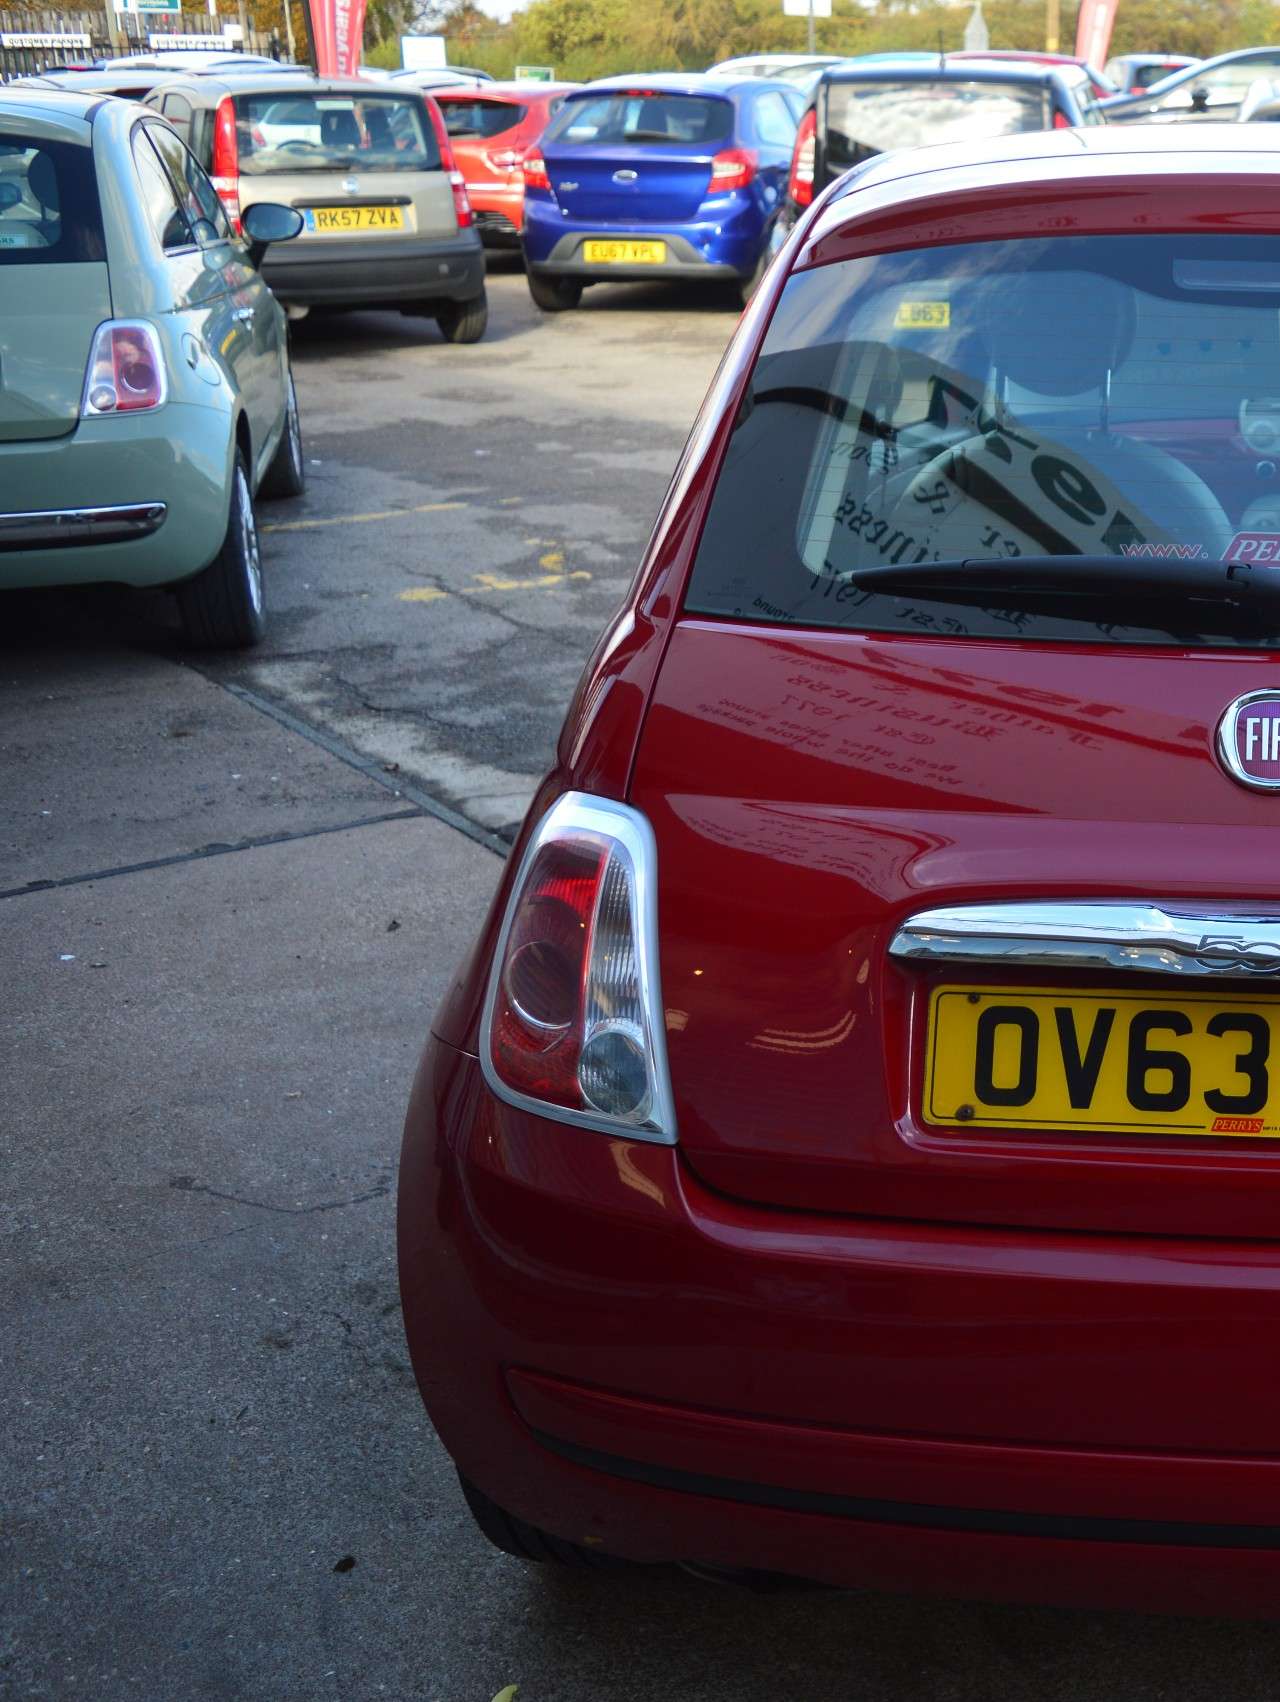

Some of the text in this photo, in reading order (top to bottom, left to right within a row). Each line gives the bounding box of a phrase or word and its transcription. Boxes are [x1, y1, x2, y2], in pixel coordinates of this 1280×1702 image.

[317, 207, 400, 227] RK57 ZVA
[974, 1005, 1271, 1116] OV63
[1213, 1119, 1262, 1131] PERRYS
